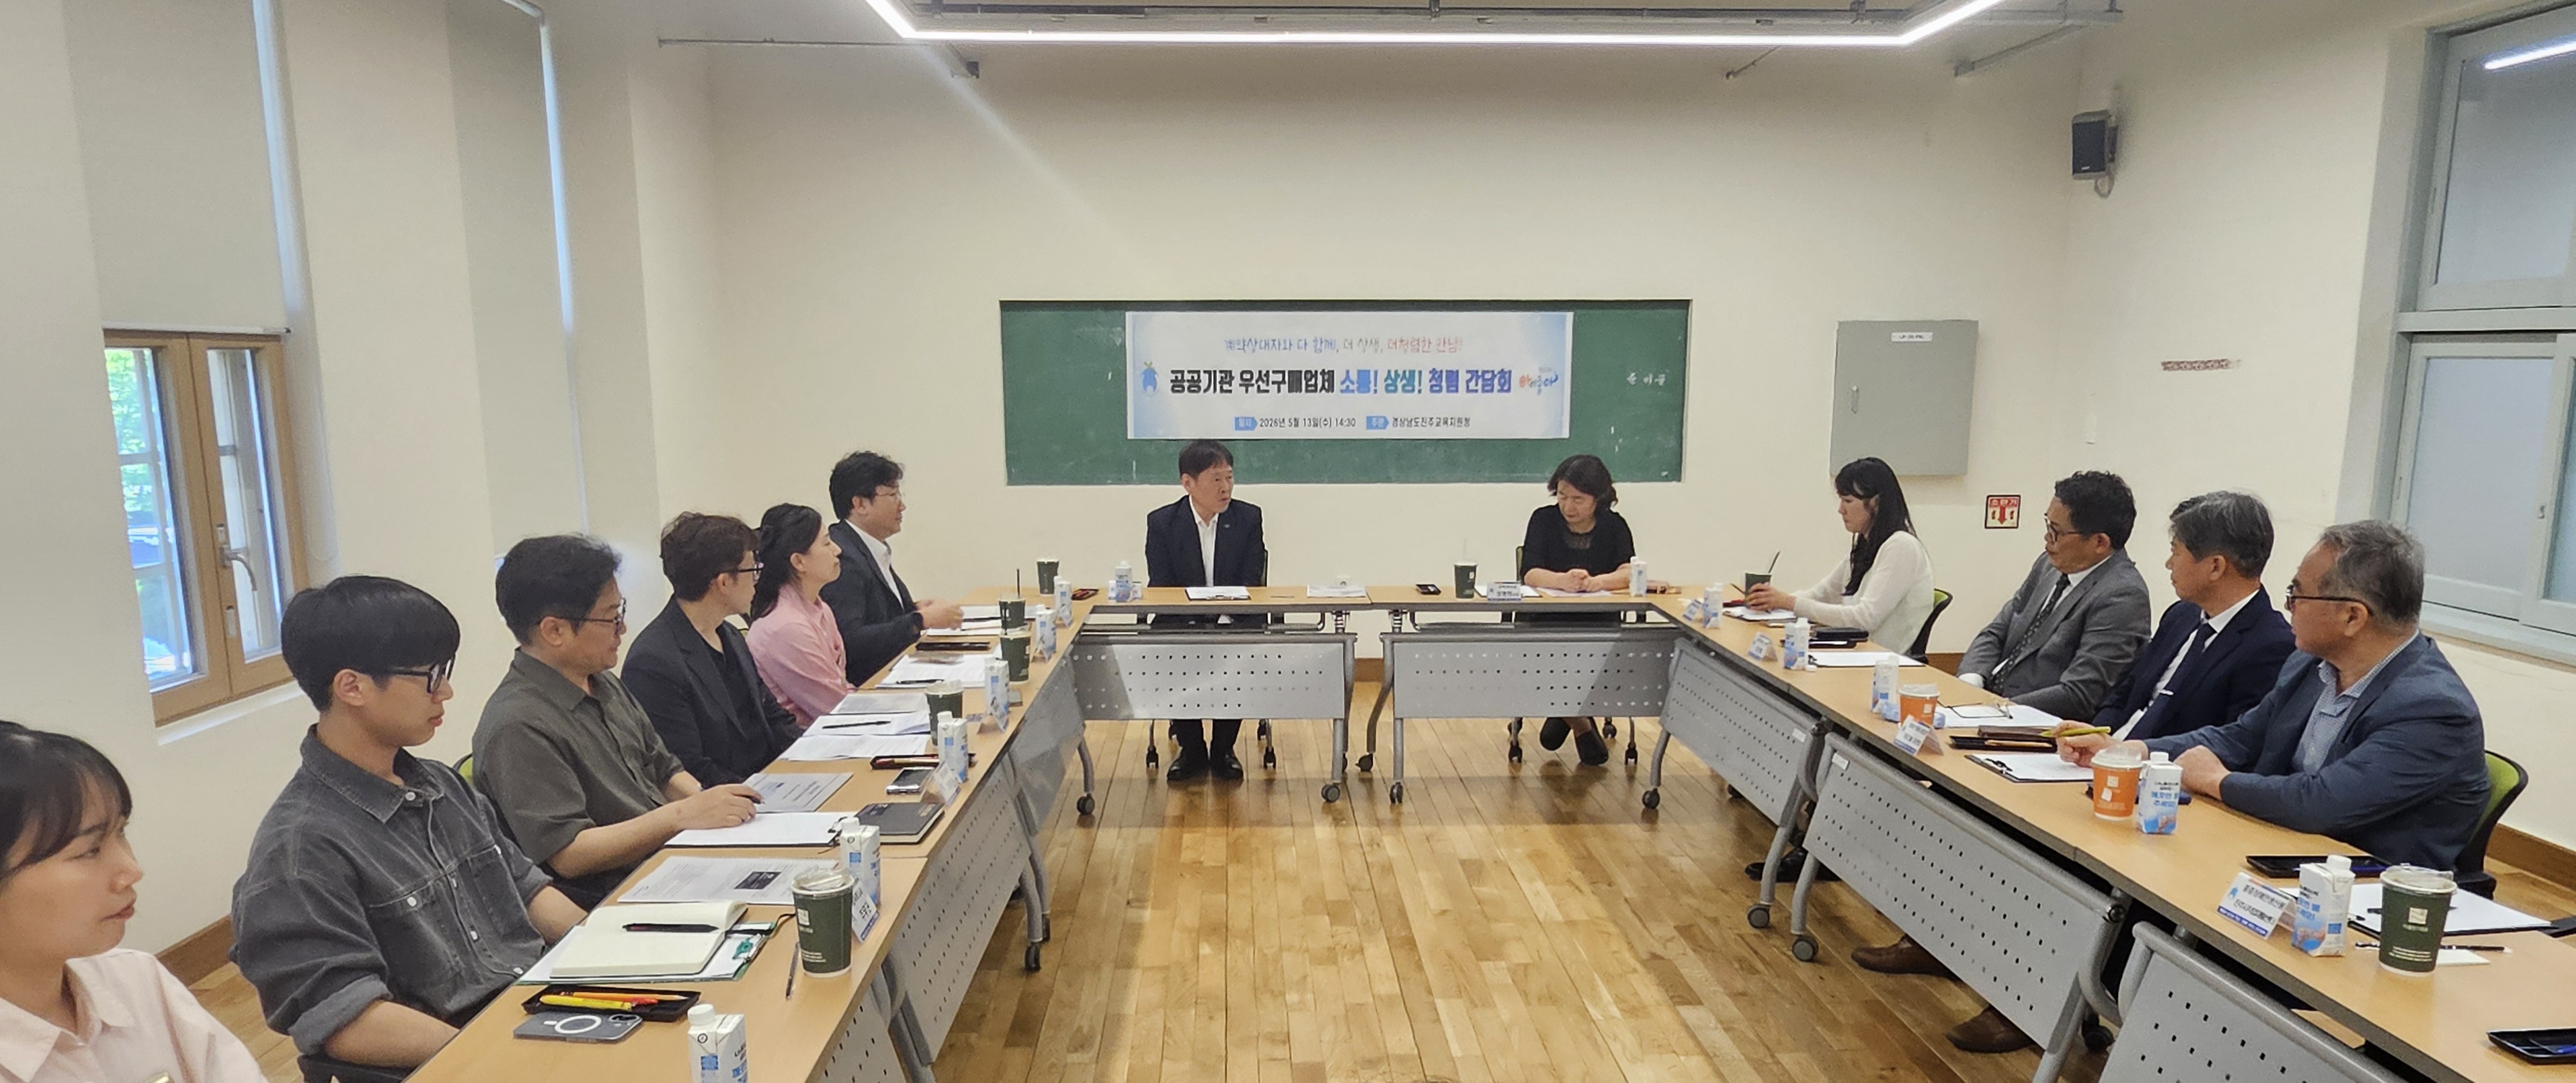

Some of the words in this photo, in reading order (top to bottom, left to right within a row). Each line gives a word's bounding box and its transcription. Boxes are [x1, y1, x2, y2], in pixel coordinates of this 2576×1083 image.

[1297, 338, 1307, 350] 다
[1343, 338, 1353, 350] 더
[1170, 370, 1235, 394] 공공기관
[1239, 369, 1335, 394] 우선구매업체
[1384, 369, 1422, 394] 상생!
[1428, 368, 1459, 394] 청렴
[1466, 368, 1512, 394] 간담회
[1260, 417, 1285, 428] 2026년
[1335, 417, 1356, 428] 14:30
